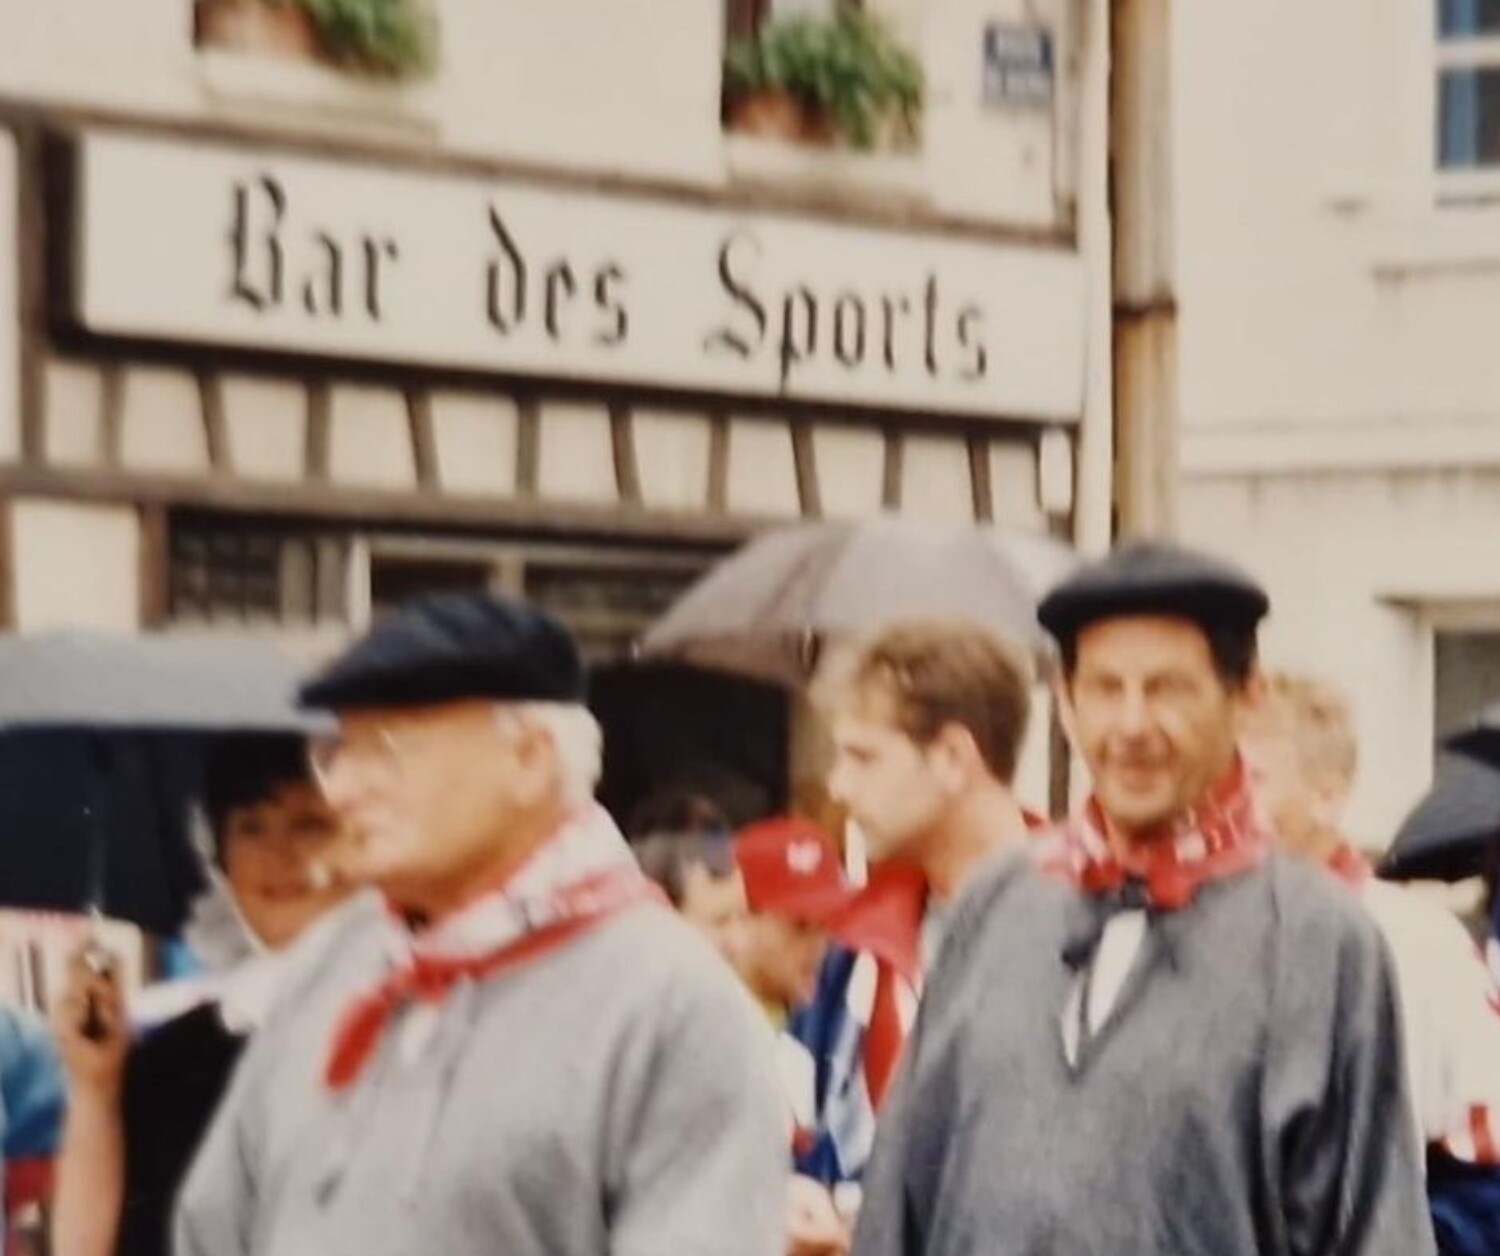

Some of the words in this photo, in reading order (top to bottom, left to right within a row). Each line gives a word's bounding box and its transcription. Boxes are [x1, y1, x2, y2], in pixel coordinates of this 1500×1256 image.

[228, 175, 399, 324] Bar
[483, 204, 630, 346] des
[703, 230, 990, 394] Sports
